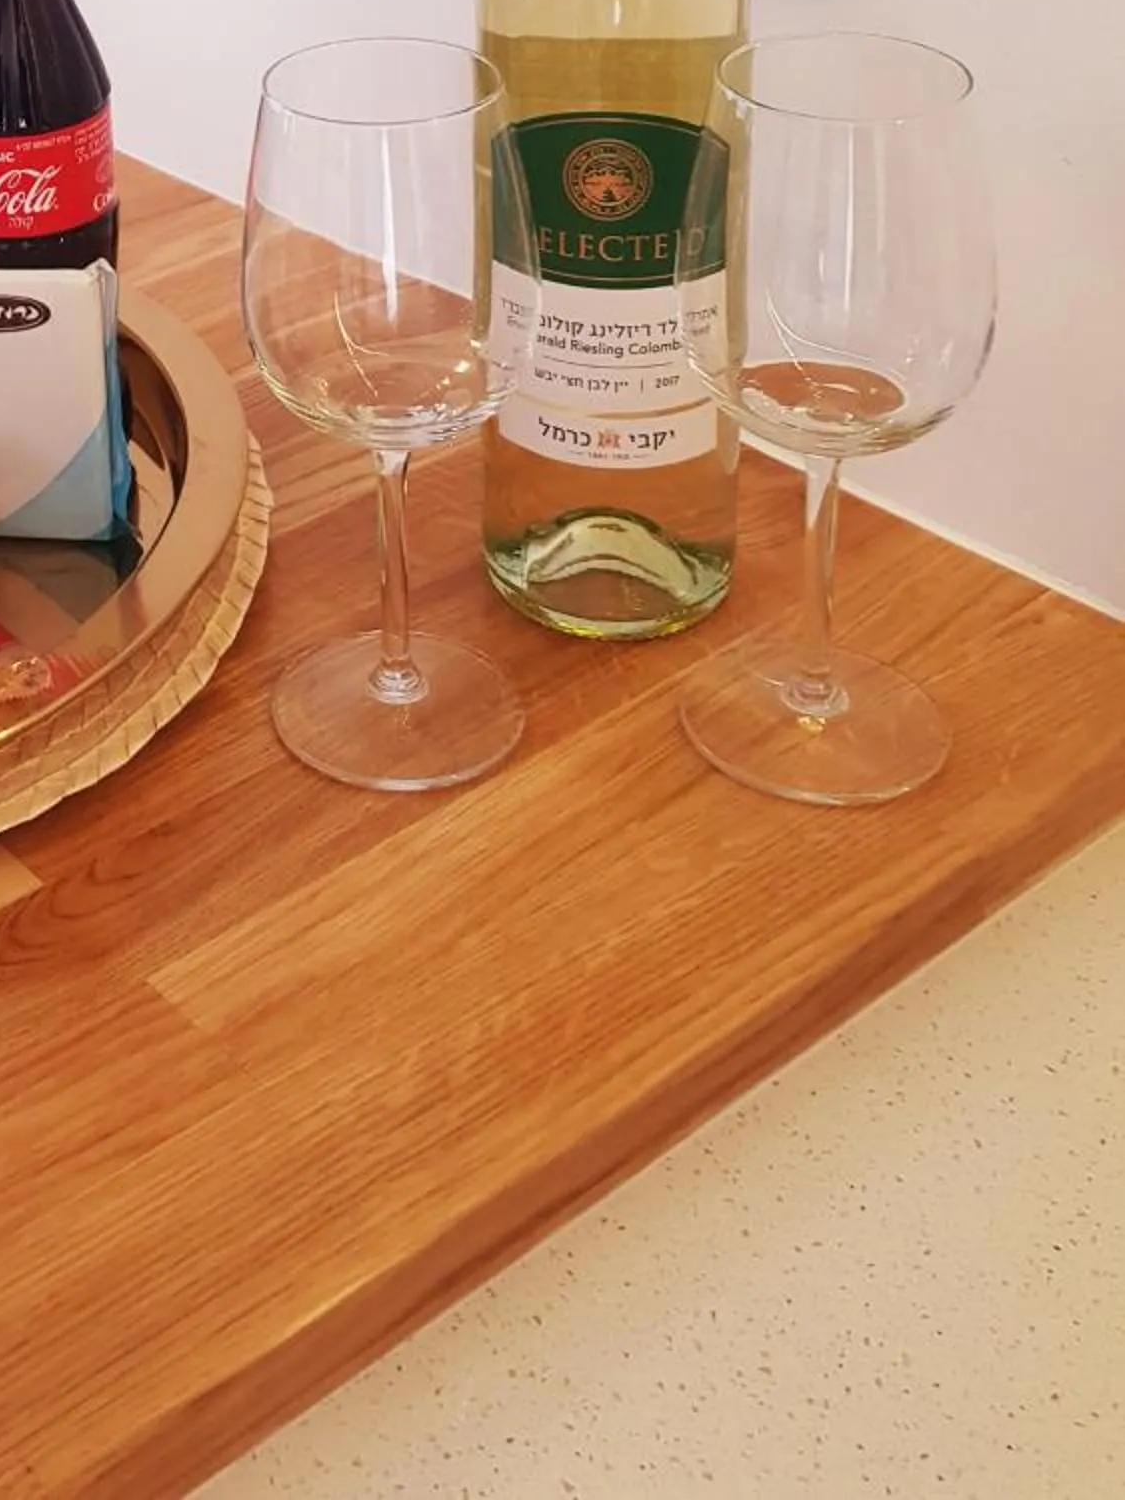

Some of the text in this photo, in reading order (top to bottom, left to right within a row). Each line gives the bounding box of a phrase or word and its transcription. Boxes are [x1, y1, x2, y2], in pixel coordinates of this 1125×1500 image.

[539, 227, 706, 263] ELECTED
[570, 339, 625, 359] Riesling
[538, 416, 676, 451] יקבי כרמל
